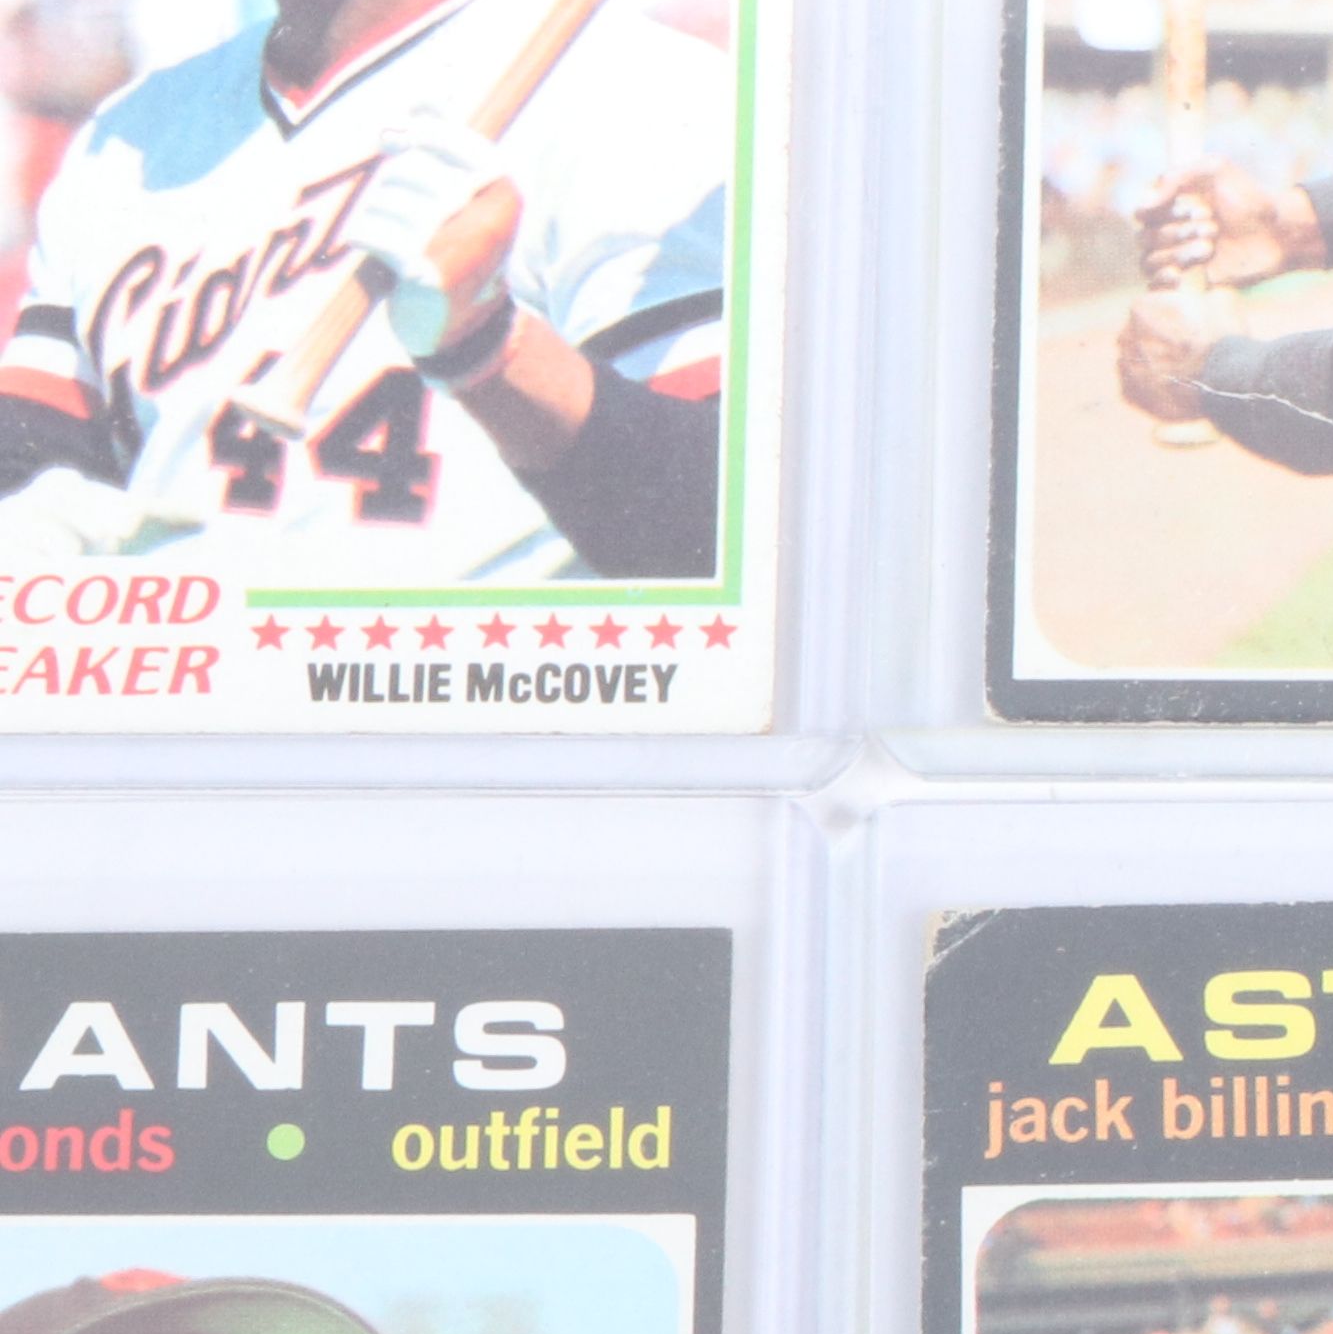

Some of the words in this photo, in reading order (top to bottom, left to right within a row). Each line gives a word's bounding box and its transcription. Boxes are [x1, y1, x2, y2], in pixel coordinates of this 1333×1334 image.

[307, 663, 452, 704] WILLIE
[466, 662, 679, 706] McCOVEY
[19, 999, 567, 1092] ANTS
[0, 1108, 176, 1173] onds
[391, 1105, 672, 1172] outfield
[982, 1079, 1134, 1160] jack
